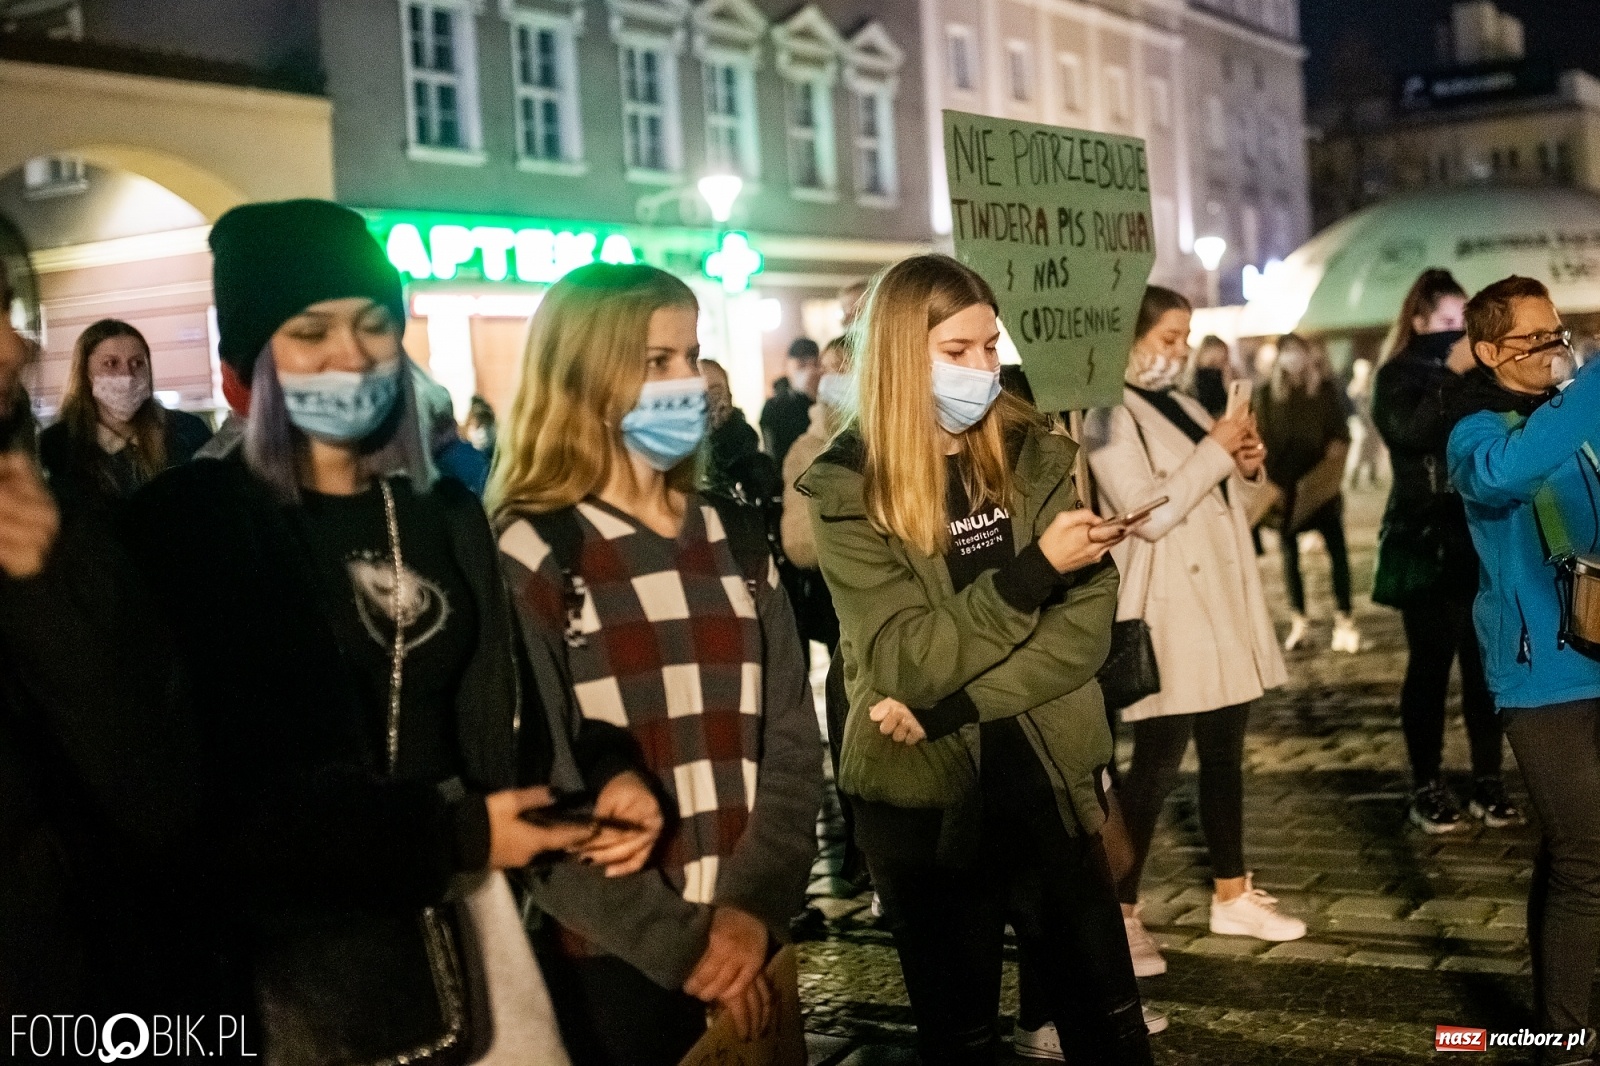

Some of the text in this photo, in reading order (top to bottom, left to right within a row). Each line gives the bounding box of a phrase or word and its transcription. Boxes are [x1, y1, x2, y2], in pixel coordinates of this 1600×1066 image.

[952, 123, 1149, 192] NIE POTRZEBUJE
[951, 198, 1150, 252] TINDERA PIS RUCHA
[386, 223, 636, 282] APTEKA
[1033, 256, 1070, 293] NAS
[1020, 306, 1123, 344] CODZIENNIE
